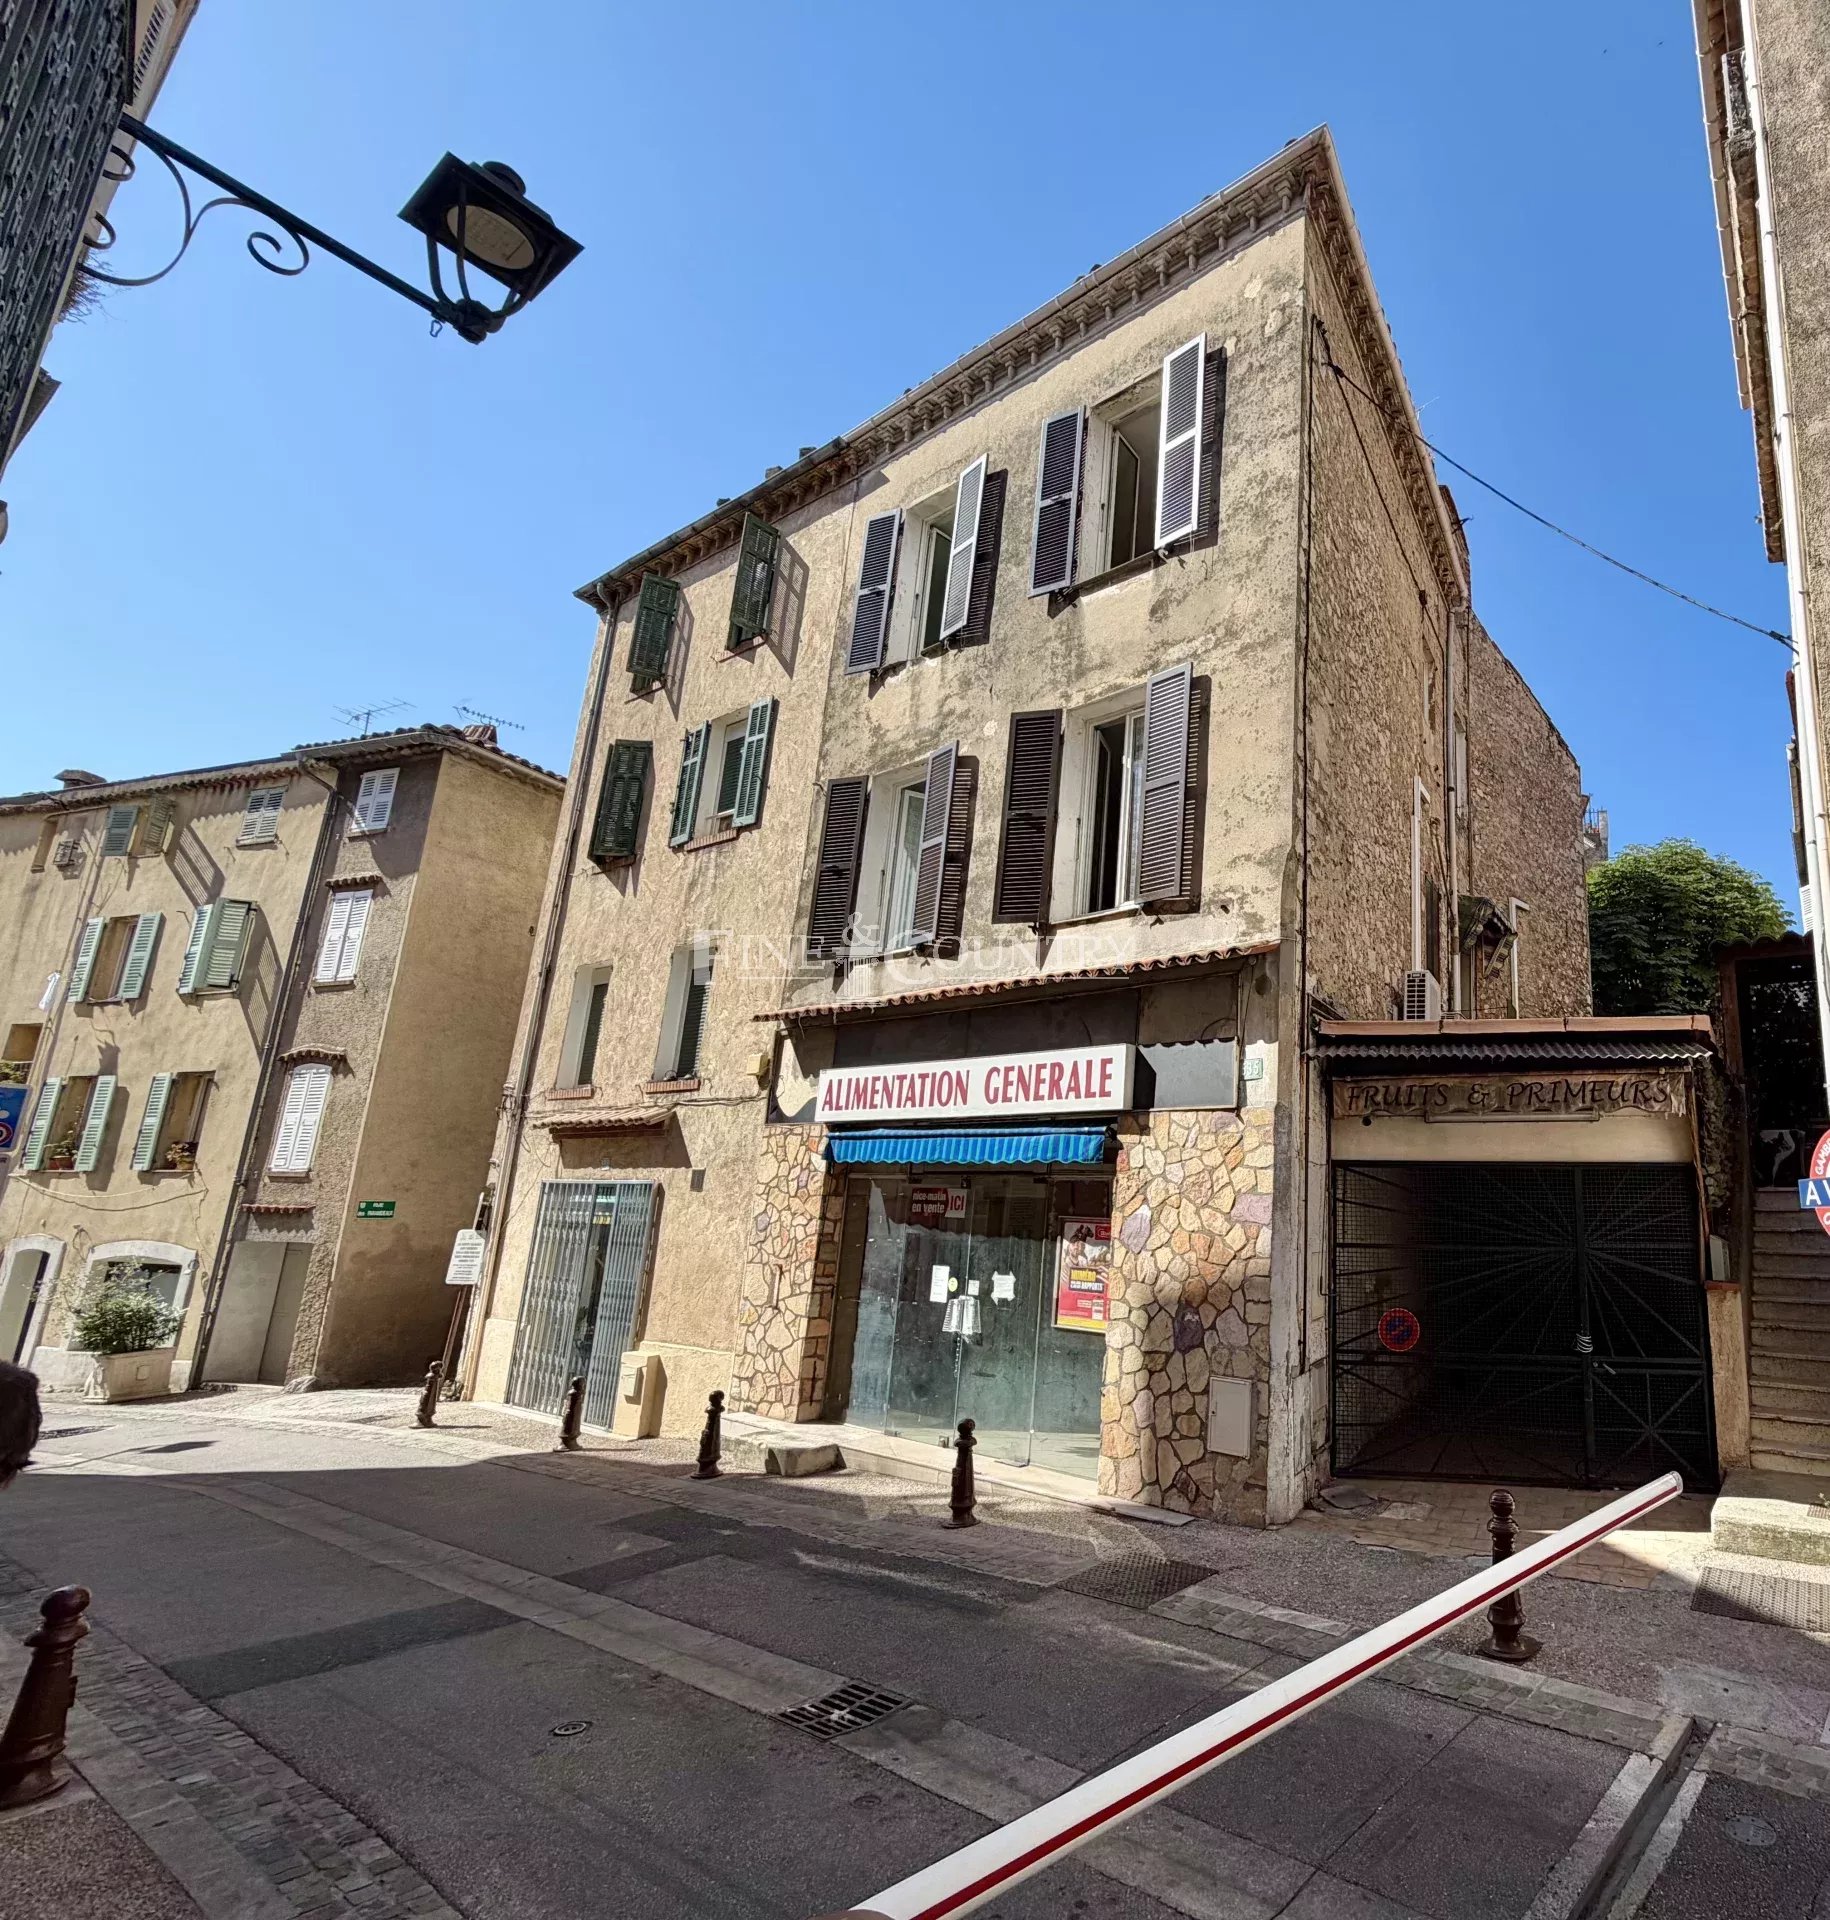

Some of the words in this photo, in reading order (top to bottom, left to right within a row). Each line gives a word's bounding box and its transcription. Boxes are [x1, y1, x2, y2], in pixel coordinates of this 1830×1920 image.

[822, 1070, 970, 1111] ALIMENTATION
[984, 1058, 1113, 1104] GENERALE
[1348, 1083, 1449, 1109] FRUITS
[1468, 1083, 1490, 1106] &
[1506, 1079, 1669, 1106] PRIMEURS
[912, 1191, 946, 1201] nice-matin
[950, 1195, 965, 1211] ICI
[912, 1202, 921, 1213] en
[923, 1202, 945, 1216] vente
